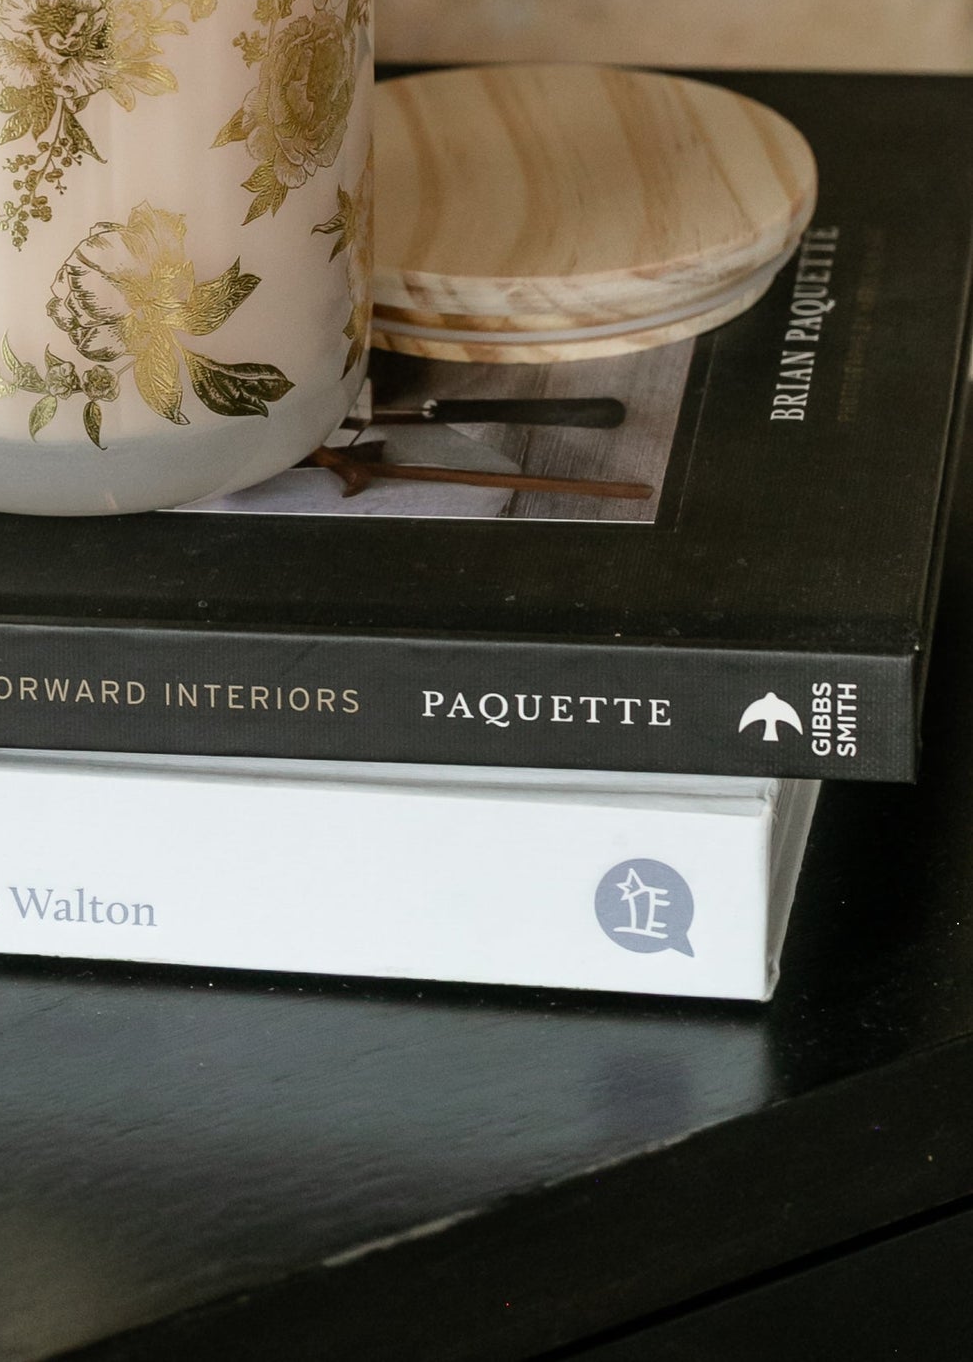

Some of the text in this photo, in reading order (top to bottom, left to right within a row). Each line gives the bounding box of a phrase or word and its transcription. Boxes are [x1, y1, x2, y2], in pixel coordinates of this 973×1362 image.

[770, 225, 839, 422] BRIAN PAQUETTE
[165, 682, 359, 714] INTERIORS
[422, 690, 672, 728] PAQUETTE
[811, 682, 832, 757] GIBBS
[836, 683, 858, 757] SMITH
[8, 886, 158, 927] Walton
